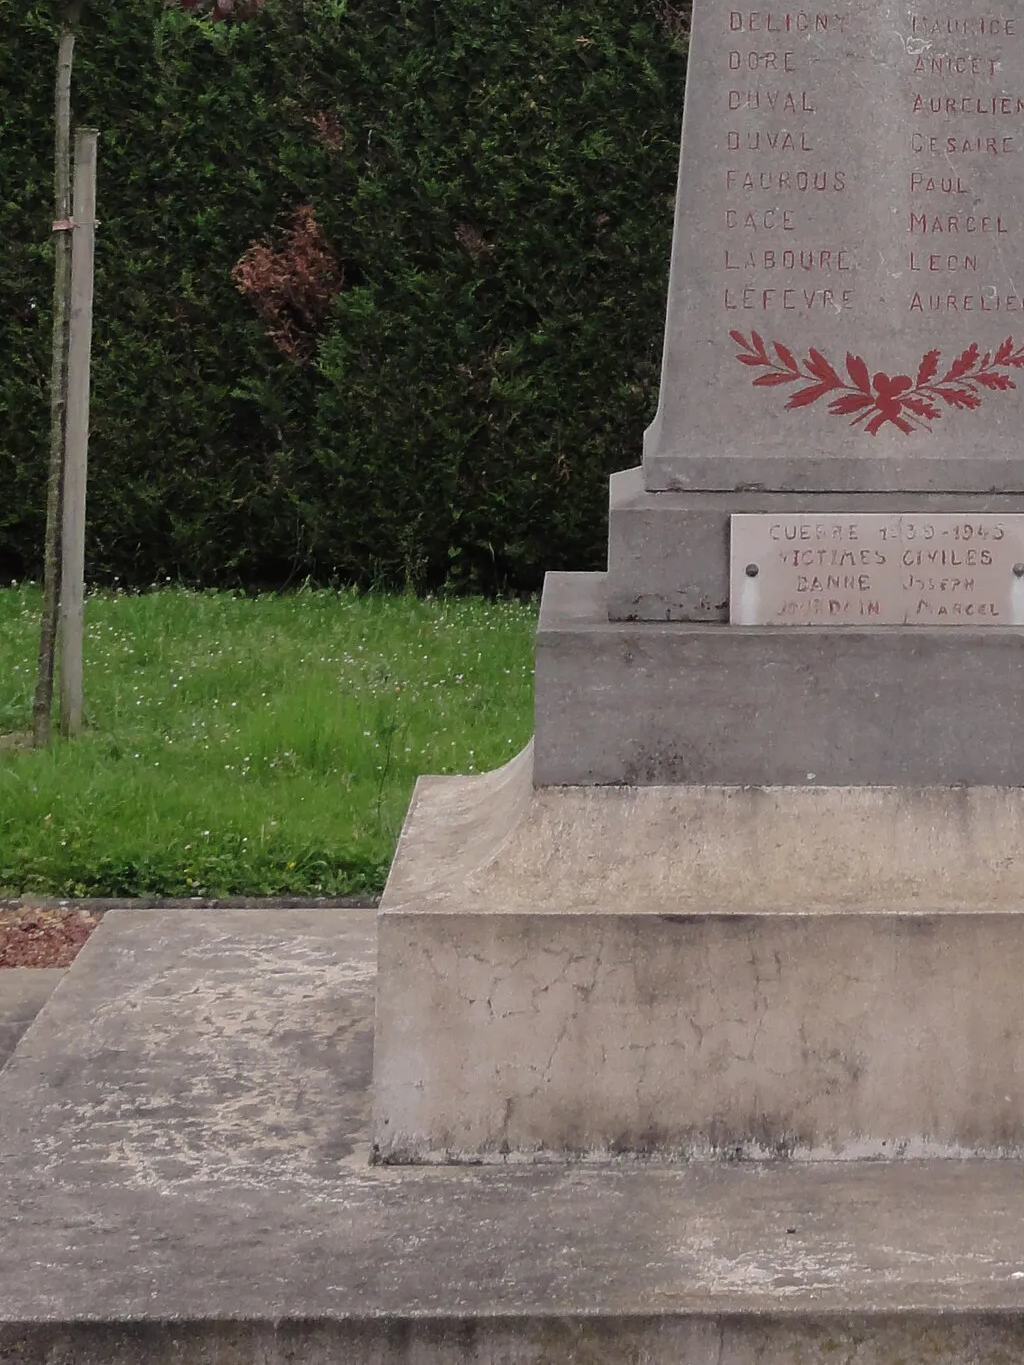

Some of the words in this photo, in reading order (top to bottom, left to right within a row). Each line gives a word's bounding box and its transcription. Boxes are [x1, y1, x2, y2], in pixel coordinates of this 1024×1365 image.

[913, 56, 999, 76] ANICET
[728, 90, 816, 112] DUVAL
[727, 131, 814, 152] DUVAL
[911, 133, 1016, 154] CESAIRE
[910, 173, 969, 194] PAUL
[910, 212, 1008, 234] MARCEL
[910, 253, 977, 272] LEON
[724, 288, 856, 310] LEFEVRE
[778, 549, 887, 566] VICTIMES
[902, 549, 993, 567] CIVILES
